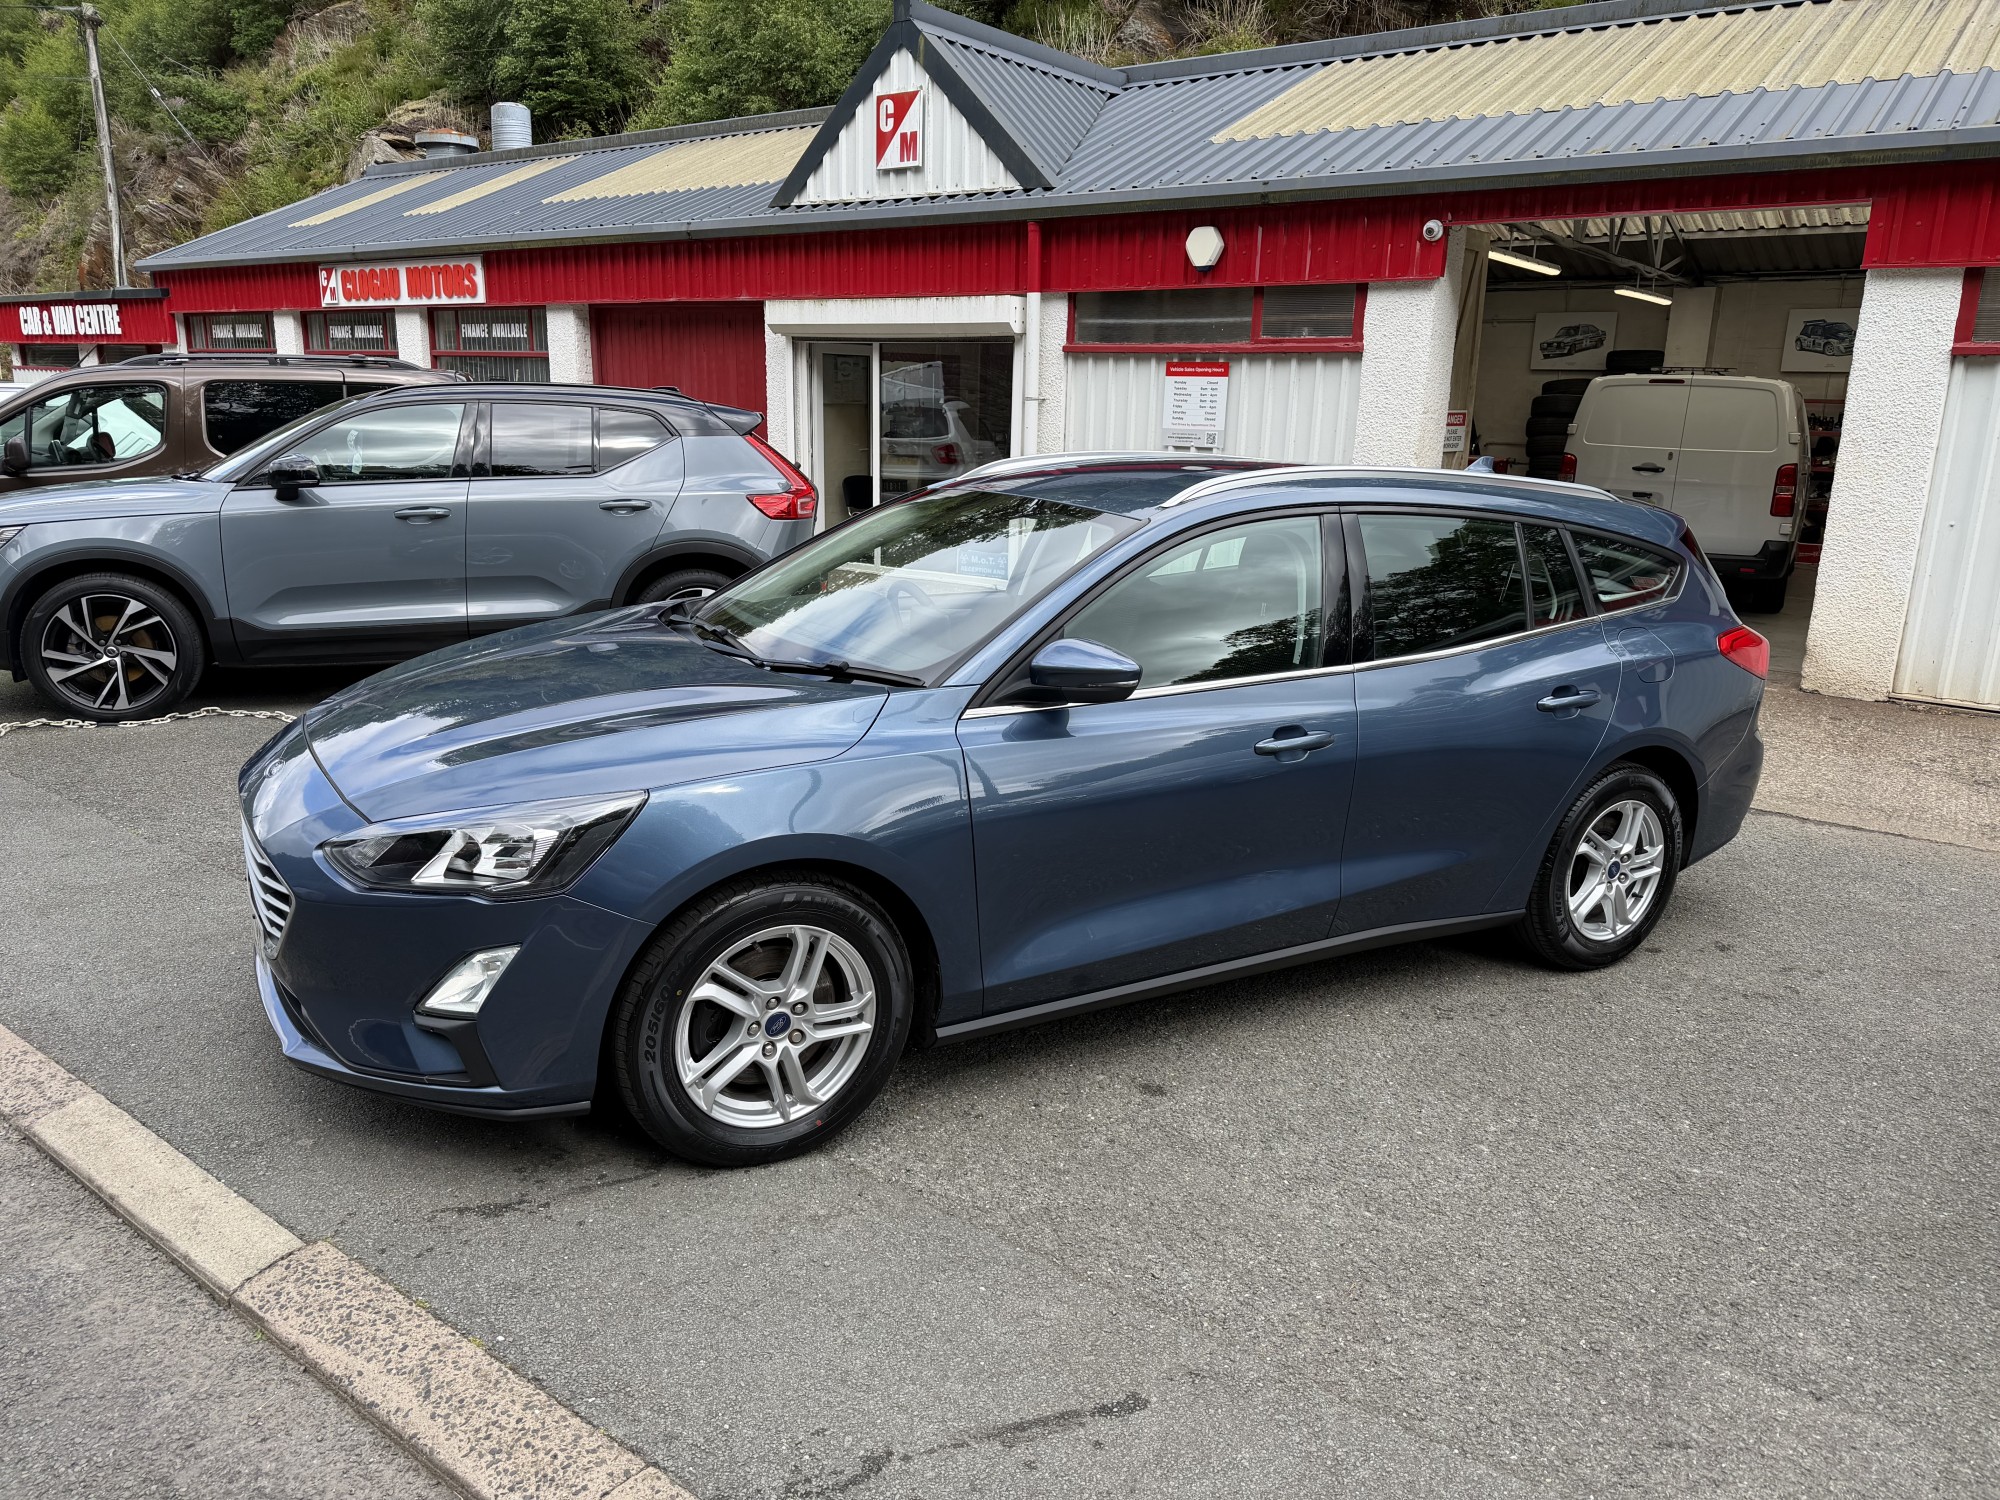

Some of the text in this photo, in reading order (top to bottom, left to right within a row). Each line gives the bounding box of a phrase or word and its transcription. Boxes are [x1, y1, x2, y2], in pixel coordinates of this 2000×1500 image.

[880, 98, 895, 132] C
[900, 131, 918, 162] M
[321, 270, 328, 287] C
[340, 263, 478, 302] CLOGAU MOTORS
[329, 286, 337, 301] M
[19, 304, 122, 336] CAR & VAN CENTRE
[212, 324, 262, 338] FINANCE AVAILABLE
[330, 325, 384, 338] FINANCE AVAILABLE
[462, 323, 528, 338] FINANCE AVAILABLE
[1447, 415, 1463, 424] ANGER
